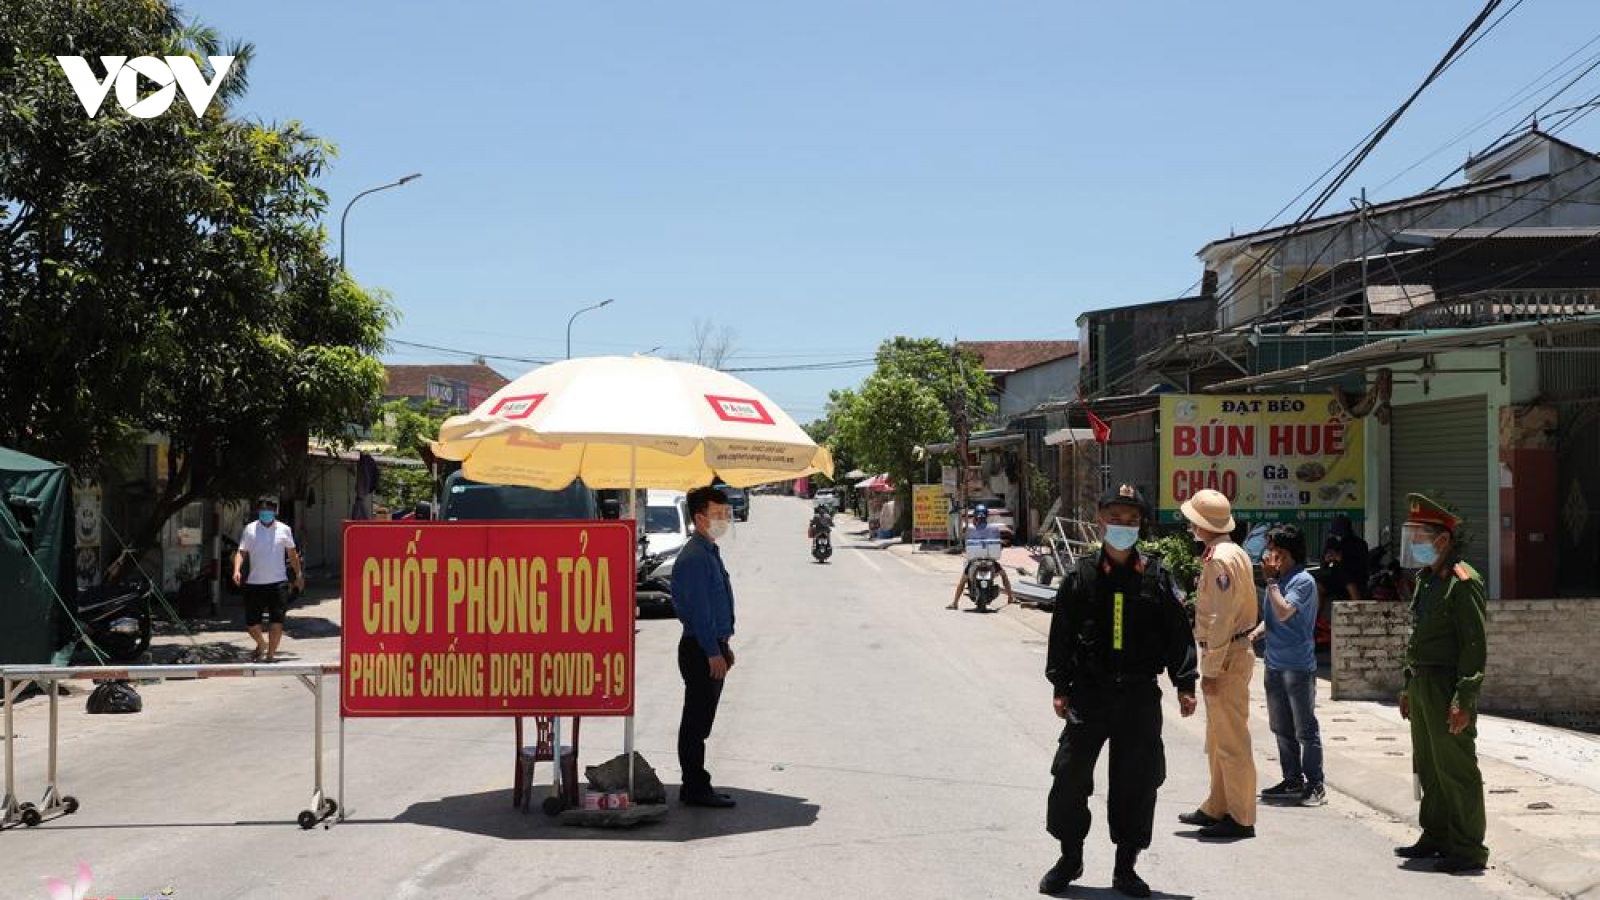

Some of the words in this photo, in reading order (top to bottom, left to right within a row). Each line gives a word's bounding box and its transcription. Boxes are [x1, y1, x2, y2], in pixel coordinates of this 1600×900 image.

[1173, 419, 1254, 456] BÚN
[362, 529, 438, 634] CHỐT
[447, 556, 548, 634] PHONG
[557, 529, 613, 634] TỎA
[350, 641, 414, 697] PHÒNG
[420, 637, 484, 697] CHỐNG
[490, 653, 534, 706] DỊCH
[540, 653, 625, 699] COVID-19
